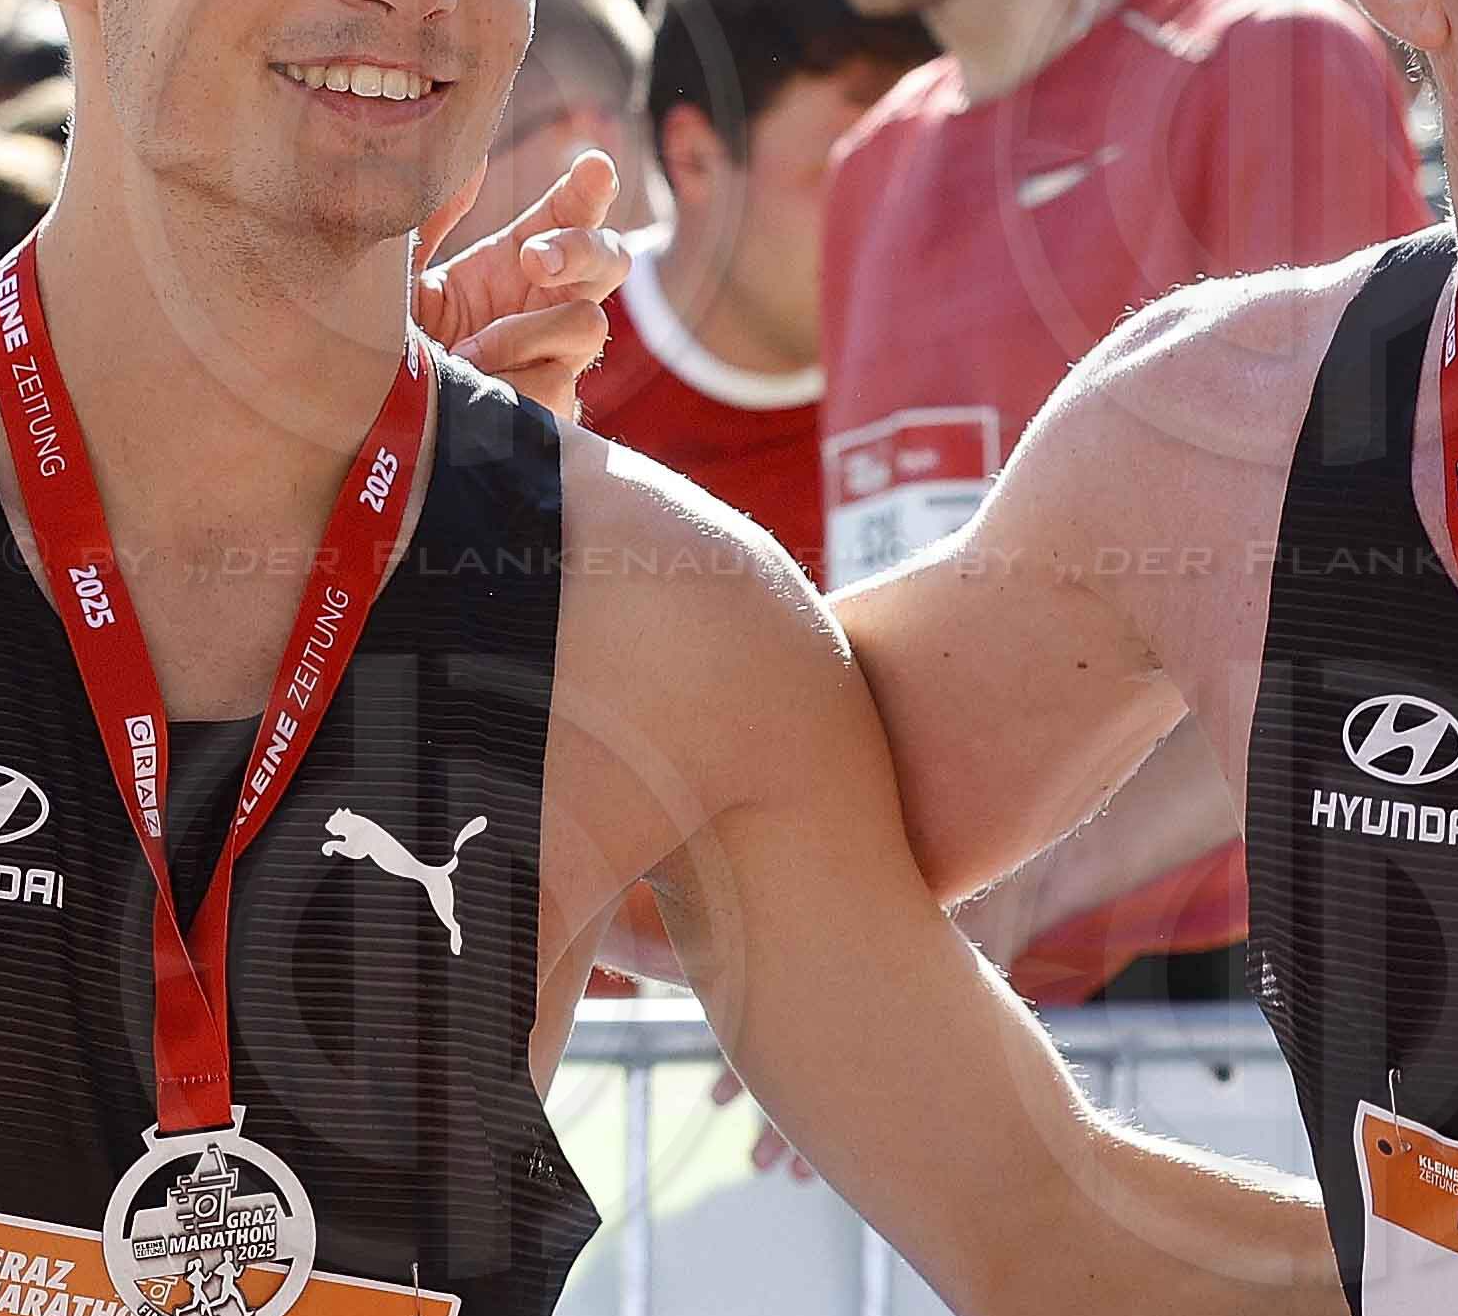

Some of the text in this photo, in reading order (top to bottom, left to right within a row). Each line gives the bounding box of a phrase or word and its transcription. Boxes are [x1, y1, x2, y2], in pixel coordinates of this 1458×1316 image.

[12, 355, 66, 478] ZEITUNG
[358, 446, 401, 515] 2025
[68, 564, 117, 630] 2025
[287, 585, 350, 712] ZEITUNG
[124, 714, 162, 838] GRAZ
[169, 1225, 276, 1254] MARATHON
[226, 1206, 277, 1229] GRAZ
[237, 1242, 276, 1261] 2025
